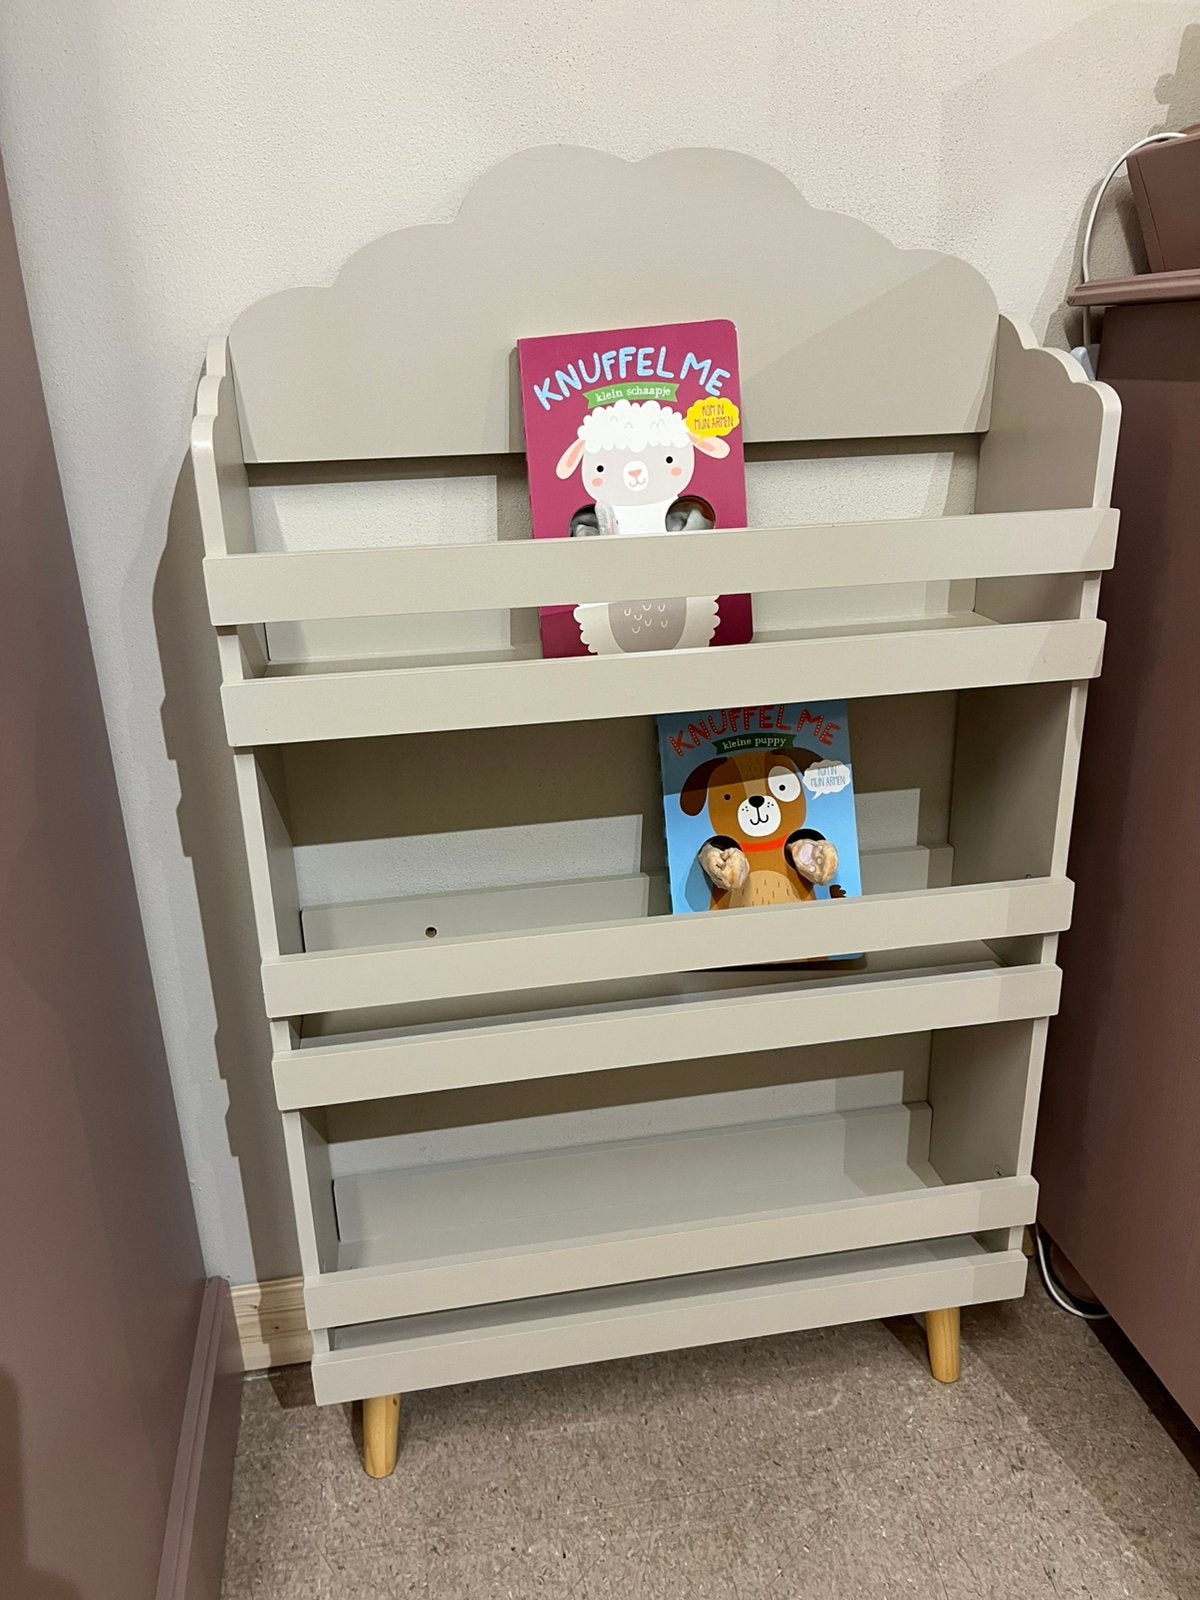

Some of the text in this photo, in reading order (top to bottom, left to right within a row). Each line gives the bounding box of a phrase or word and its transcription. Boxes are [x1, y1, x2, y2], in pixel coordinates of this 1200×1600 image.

[533, 345, 731, 411] KNUFFEL ME
[595, 387, 671, 402] klein schaapje
[702, 403, 725, 416] KOM IN
[711, 416, 734, 428] ARMEN
[669, 704, 841, 757] KNUFFEL ME
[722, 736, 787, 750] kleine puppy
[826, 774, 847, 786] ARMEN
